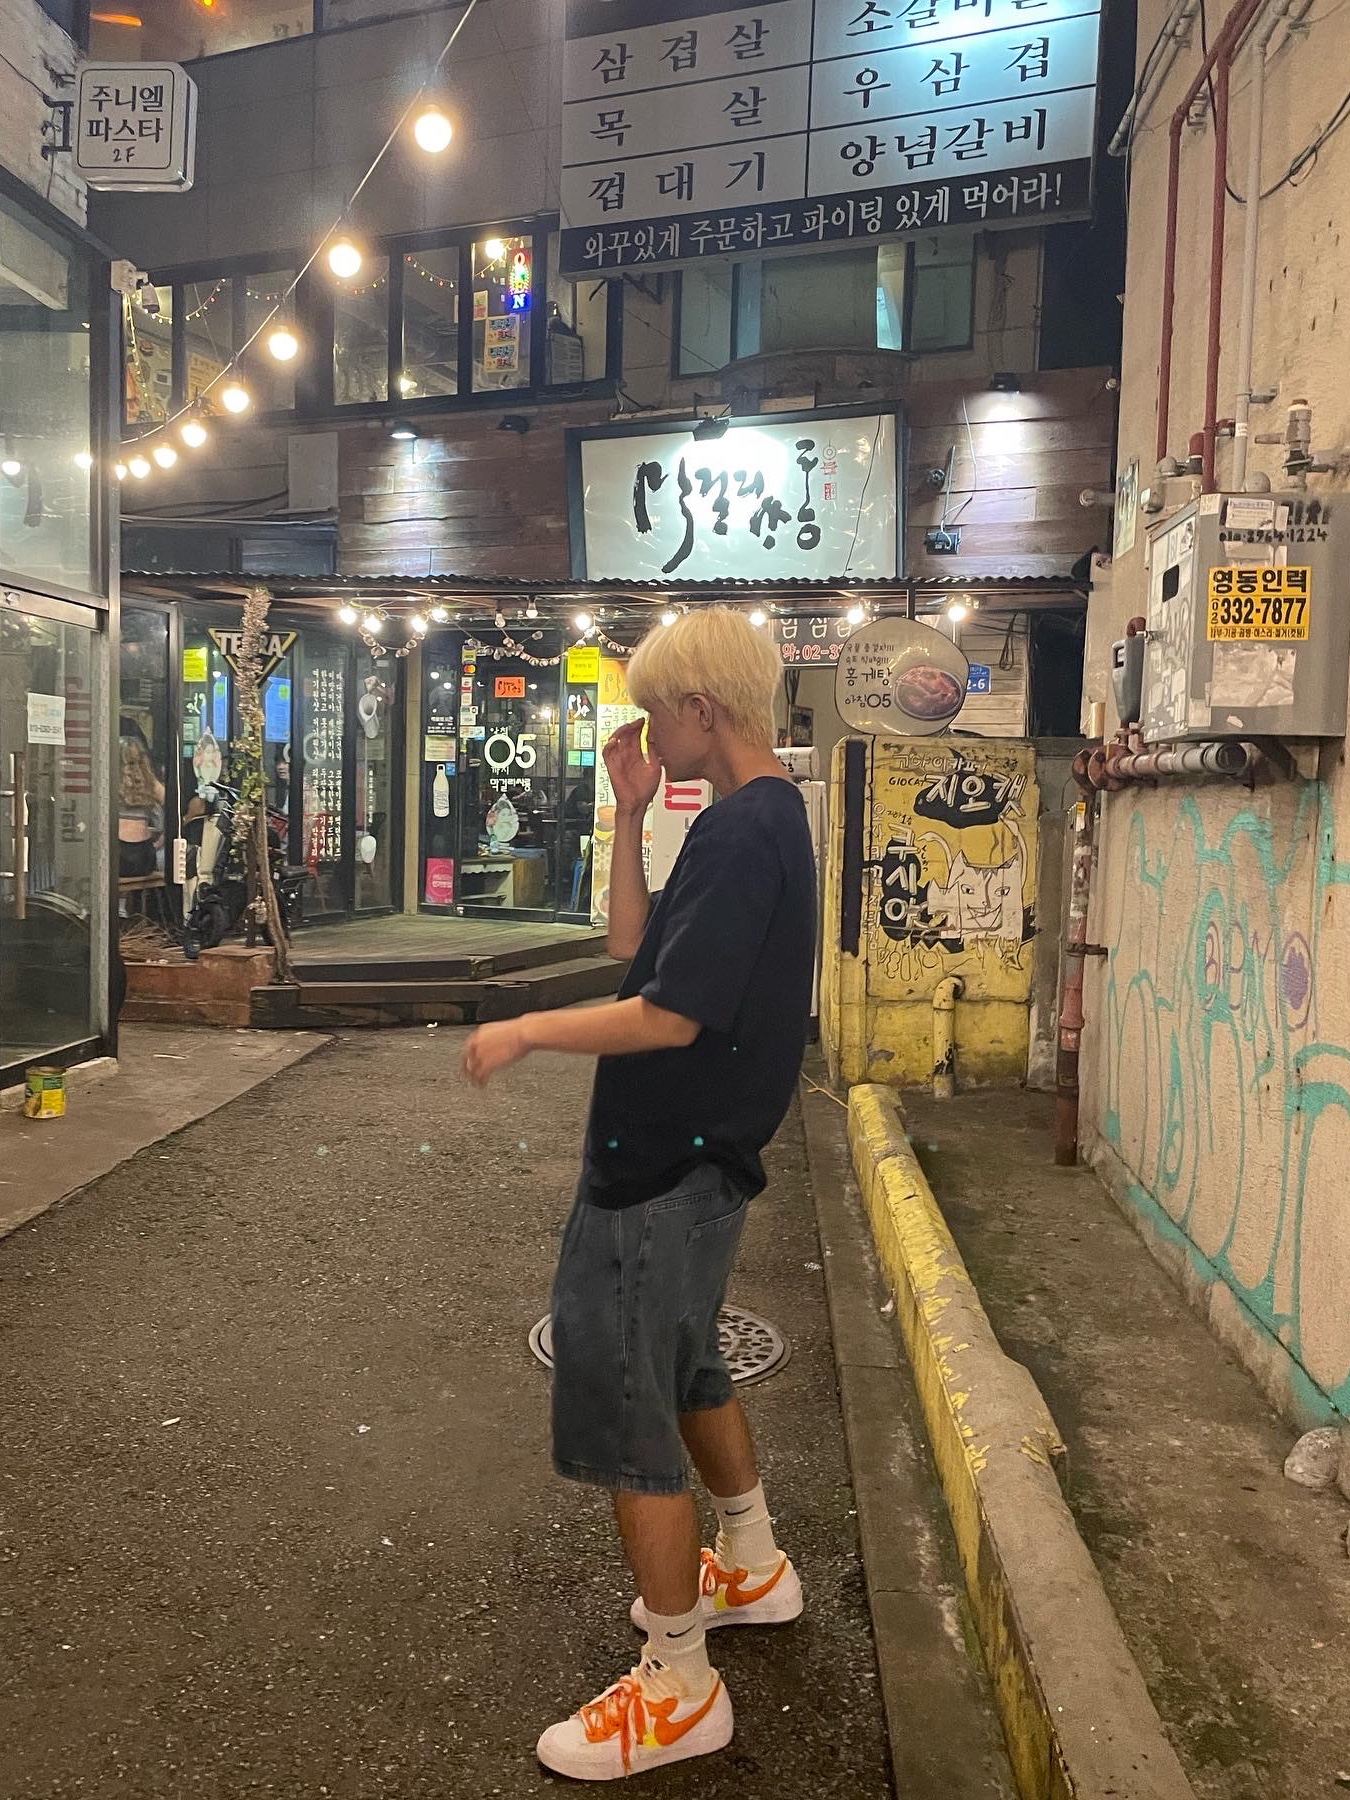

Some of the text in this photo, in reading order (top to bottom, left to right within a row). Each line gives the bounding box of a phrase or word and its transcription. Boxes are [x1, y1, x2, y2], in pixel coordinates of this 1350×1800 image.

[89, 85, 163, 112] 주니엘
[87, 117, 163, 143] 파스타
[840, 109, 1047, 177] 양념갈비
[583, 172, 1062, 266] 와꾸있게 주문하고 파이팅 있게 먹어라!
[1213, 569, 1307, 594] 영동인력
[924, 773, 1027, 818] 지오캣
